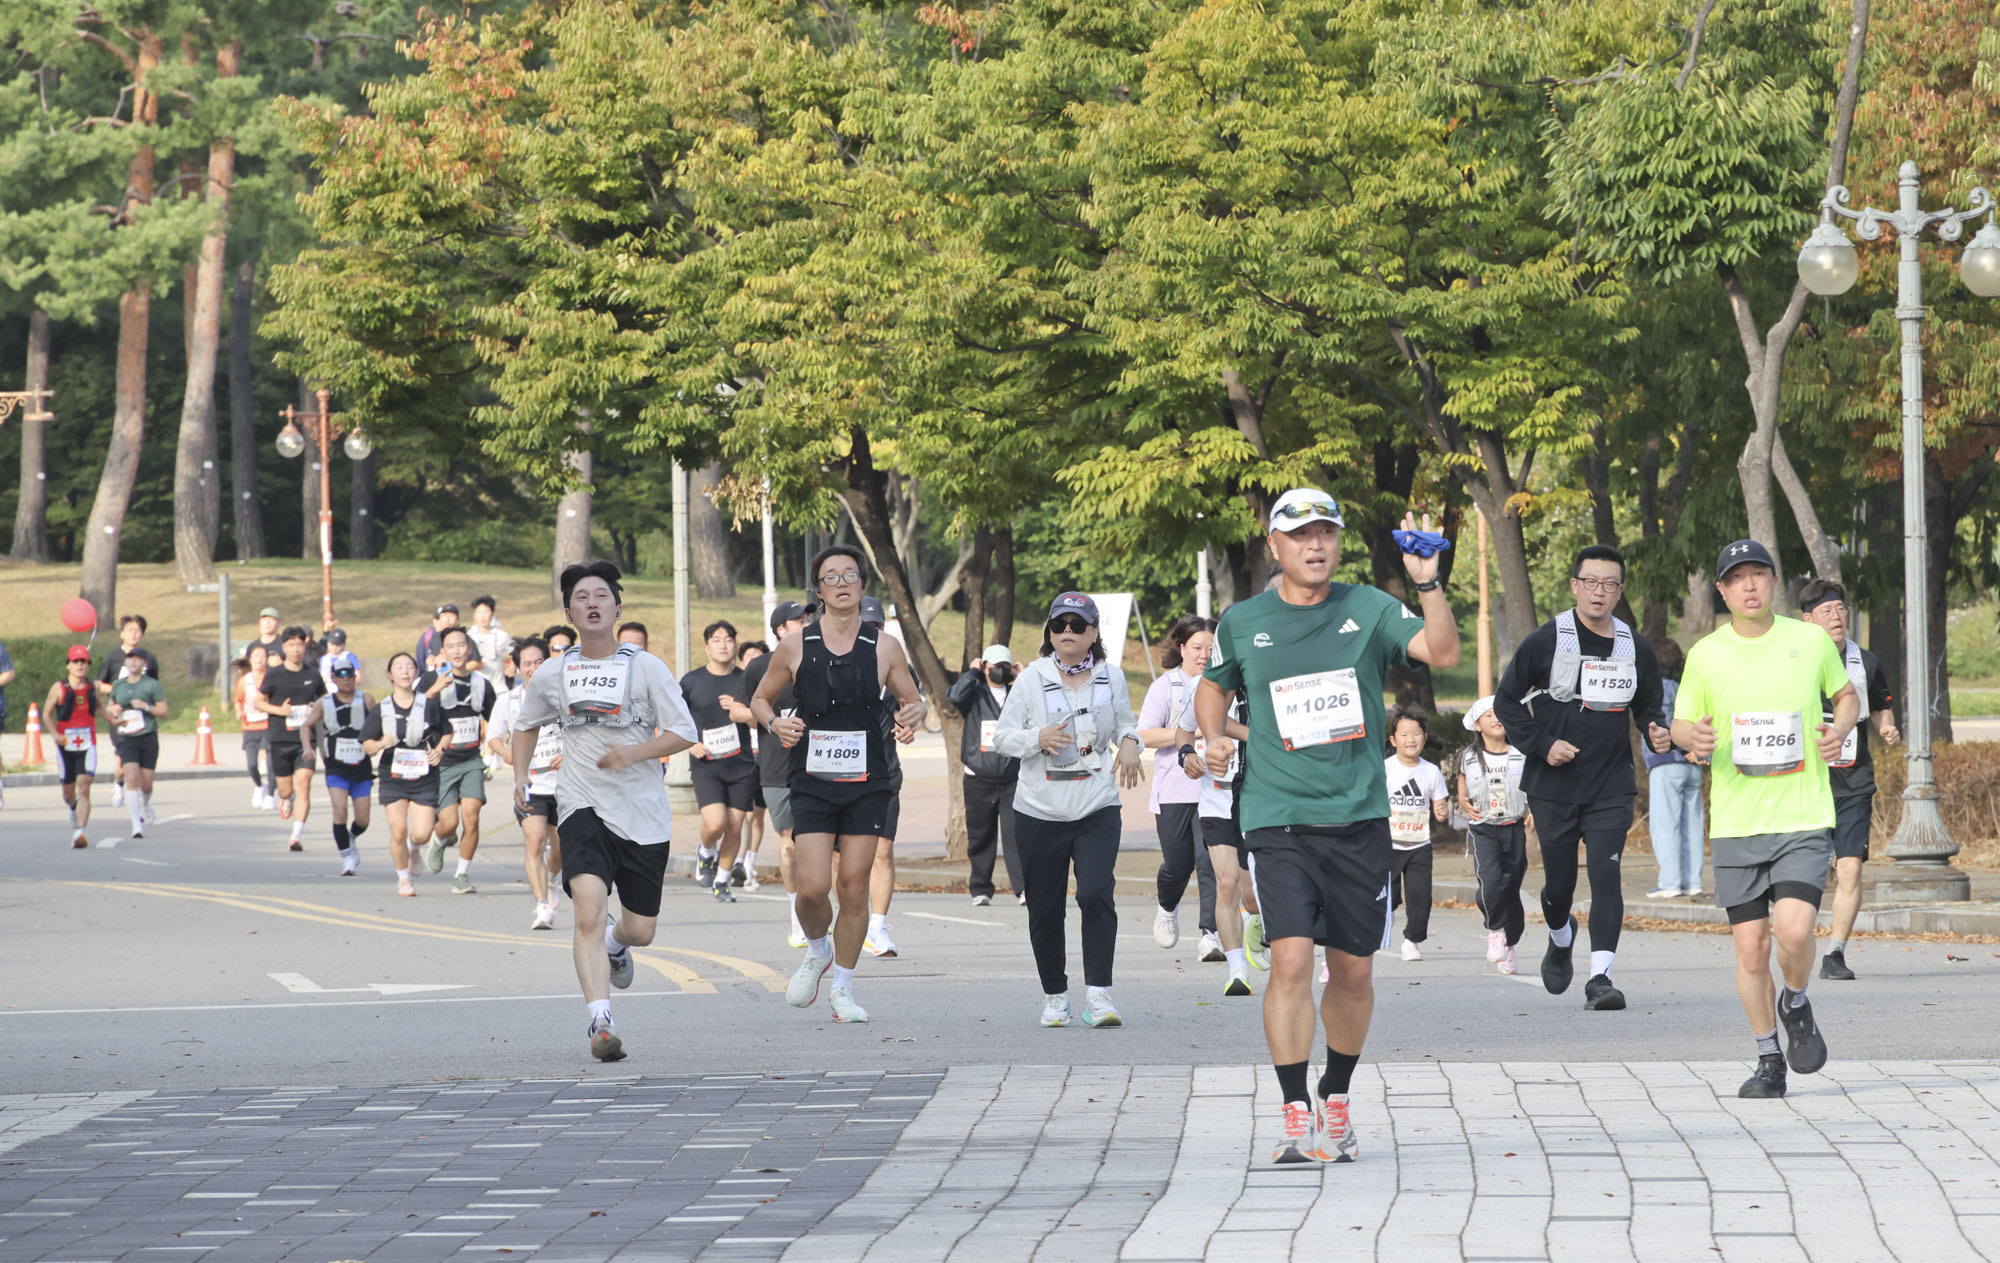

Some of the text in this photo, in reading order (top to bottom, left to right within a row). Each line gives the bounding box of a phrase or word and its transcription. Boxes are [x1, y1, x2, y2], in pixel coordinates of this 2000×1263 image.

[570, 677, 618, 688] M 1435
[1601, 678, 1633, 689] 1520
[1286, 693, 1350, 715] M 1026
[1741, 733, 1796, 747] M 1266
[815, 748, 860, 759] M 1809
[1390, 794, 1426, 807] adidas
[1398, 821, 1424, 832] 6164
